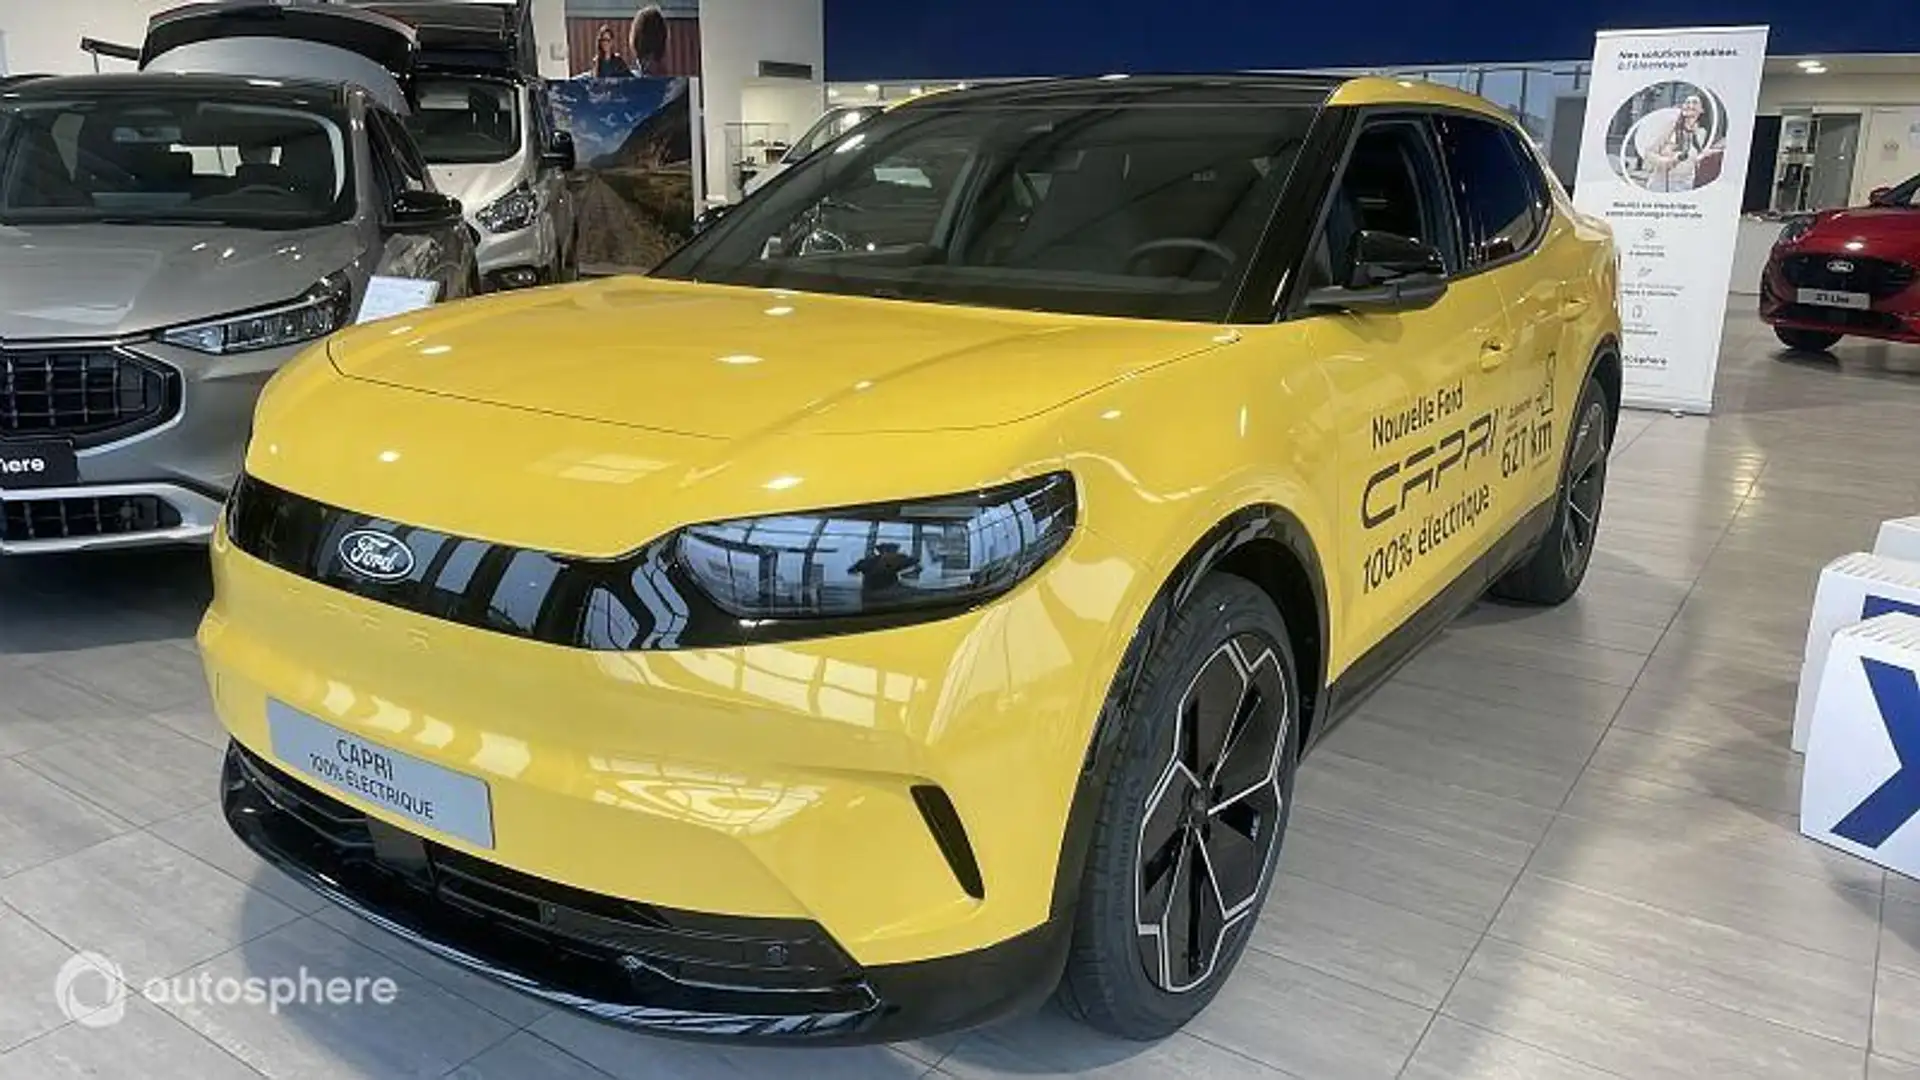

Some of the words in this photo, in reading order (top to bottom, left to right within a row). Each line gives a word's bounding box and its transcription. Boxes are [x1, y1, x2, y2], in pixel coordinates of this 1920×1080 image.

[1372, 396, 1434, 450] Nouvelle
[1437, 378, 1464, 418] Ford
[1501, 426, 1527, 479] 627
[1531, 417, 1553, 459] km
[1362, 406, 1499, 529] CAPRI
[1363, 528, 1414, 595] 100%
[1417, 484, 1490, 556] électrique
[336, 738, 394, 781] CAPRI
